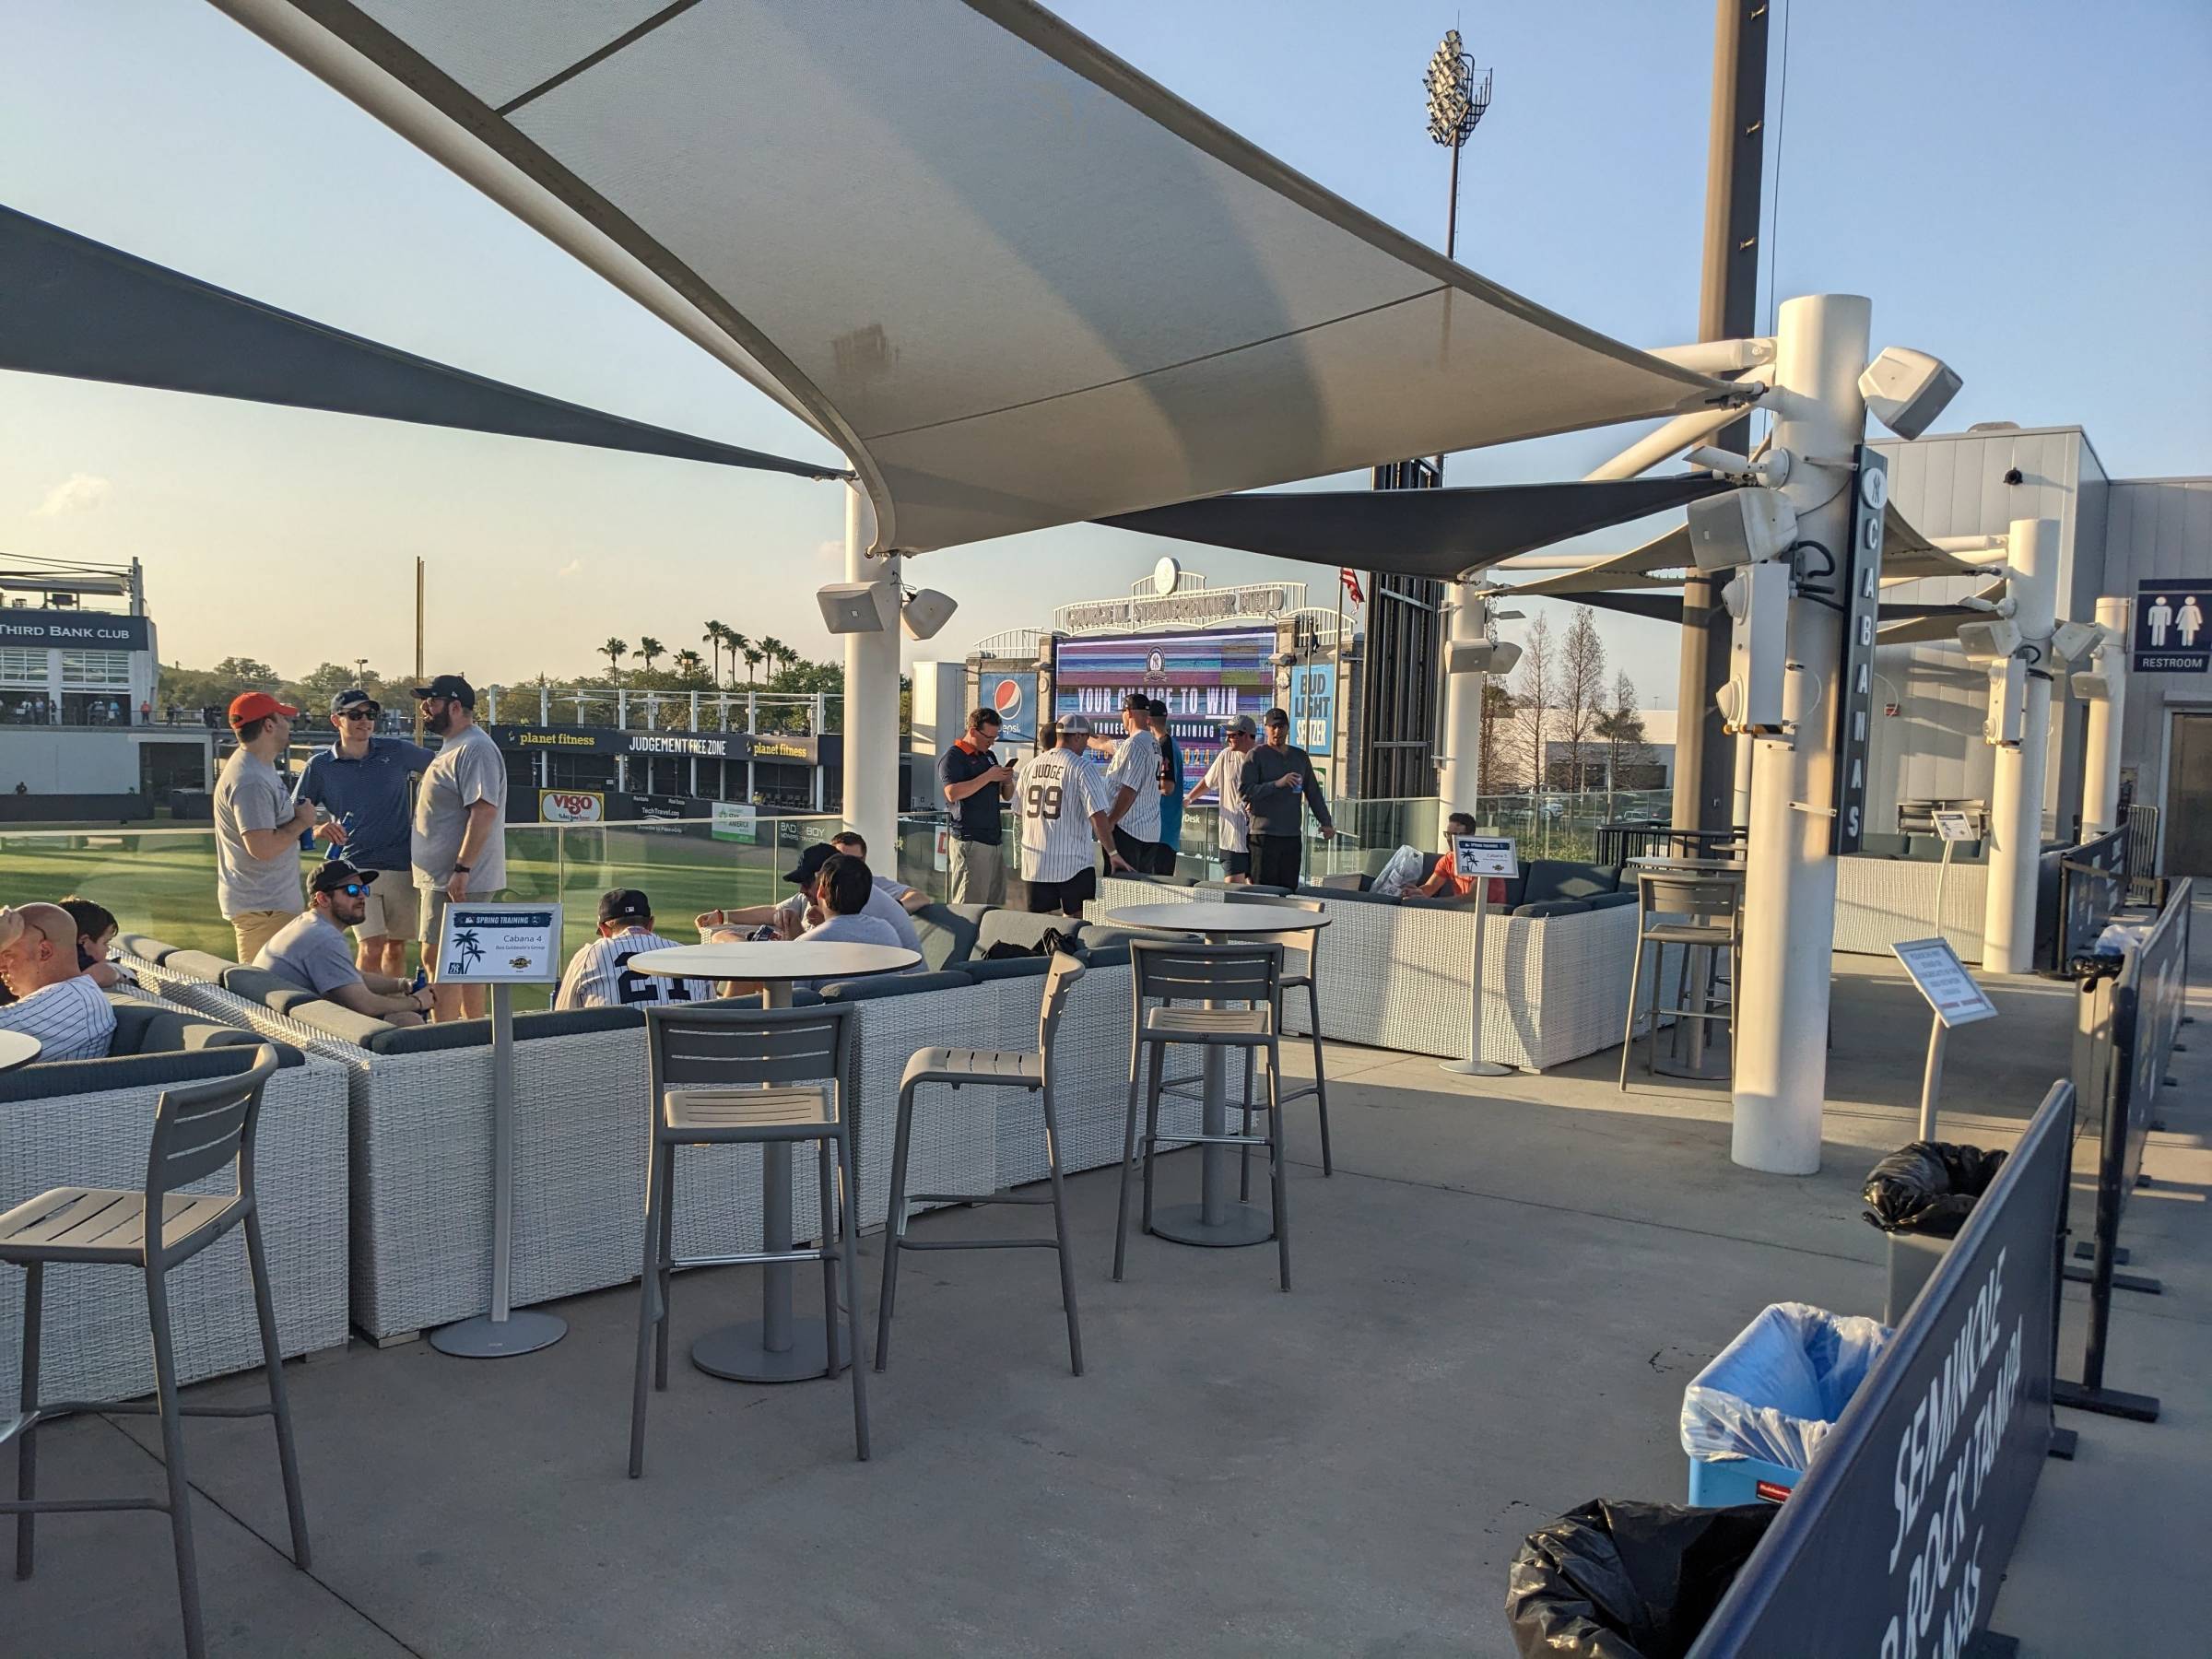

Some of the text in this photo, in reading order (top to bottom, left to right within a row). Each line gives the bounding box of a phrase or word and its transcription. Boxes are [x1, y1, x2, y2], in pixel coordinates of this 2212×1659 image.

[1238, 589, 1285, 613] FIELD
[0, 624, 130, 639] THIRD BANK CLUB
[2142, 657, 2203, 668] RESTROOM
[1300, 673, 1326, 695] BUD
[1847, 517, 1879, 838] CABANAS
[1077, 686, 1238, 715] YOUR CNCE TO WIN
[1294, 696, 1331, 718] LIGHT
[997, 724, 1019, 735] epsi
[1170, 724, 1215, 737] TRAINING
[1296, 719, 1326, 746] SETZER
[520, 732, 595, 746] planet fitness
[629, 736, 726, 756] JUDGEMENT FREE ZONE
[753, 742, 807, 758] planet fitness
[1183, 748, 1210, 765] 024
[1032, 763, 1065, 781] JUDGE
[1027, 784, 1064, 819] 99
[781, 821, 826, 838] BAD BOY
[476, 916, 529, 924] SPRING TRAINING
[503, 935, 542, 943] Cabana 4
[1888, 1246, 2006, 1575] SEMINOLE
[1903, 1437, 1971, 1659] ROCK
[1971, 1312, 2023, 1511] TAMPA
